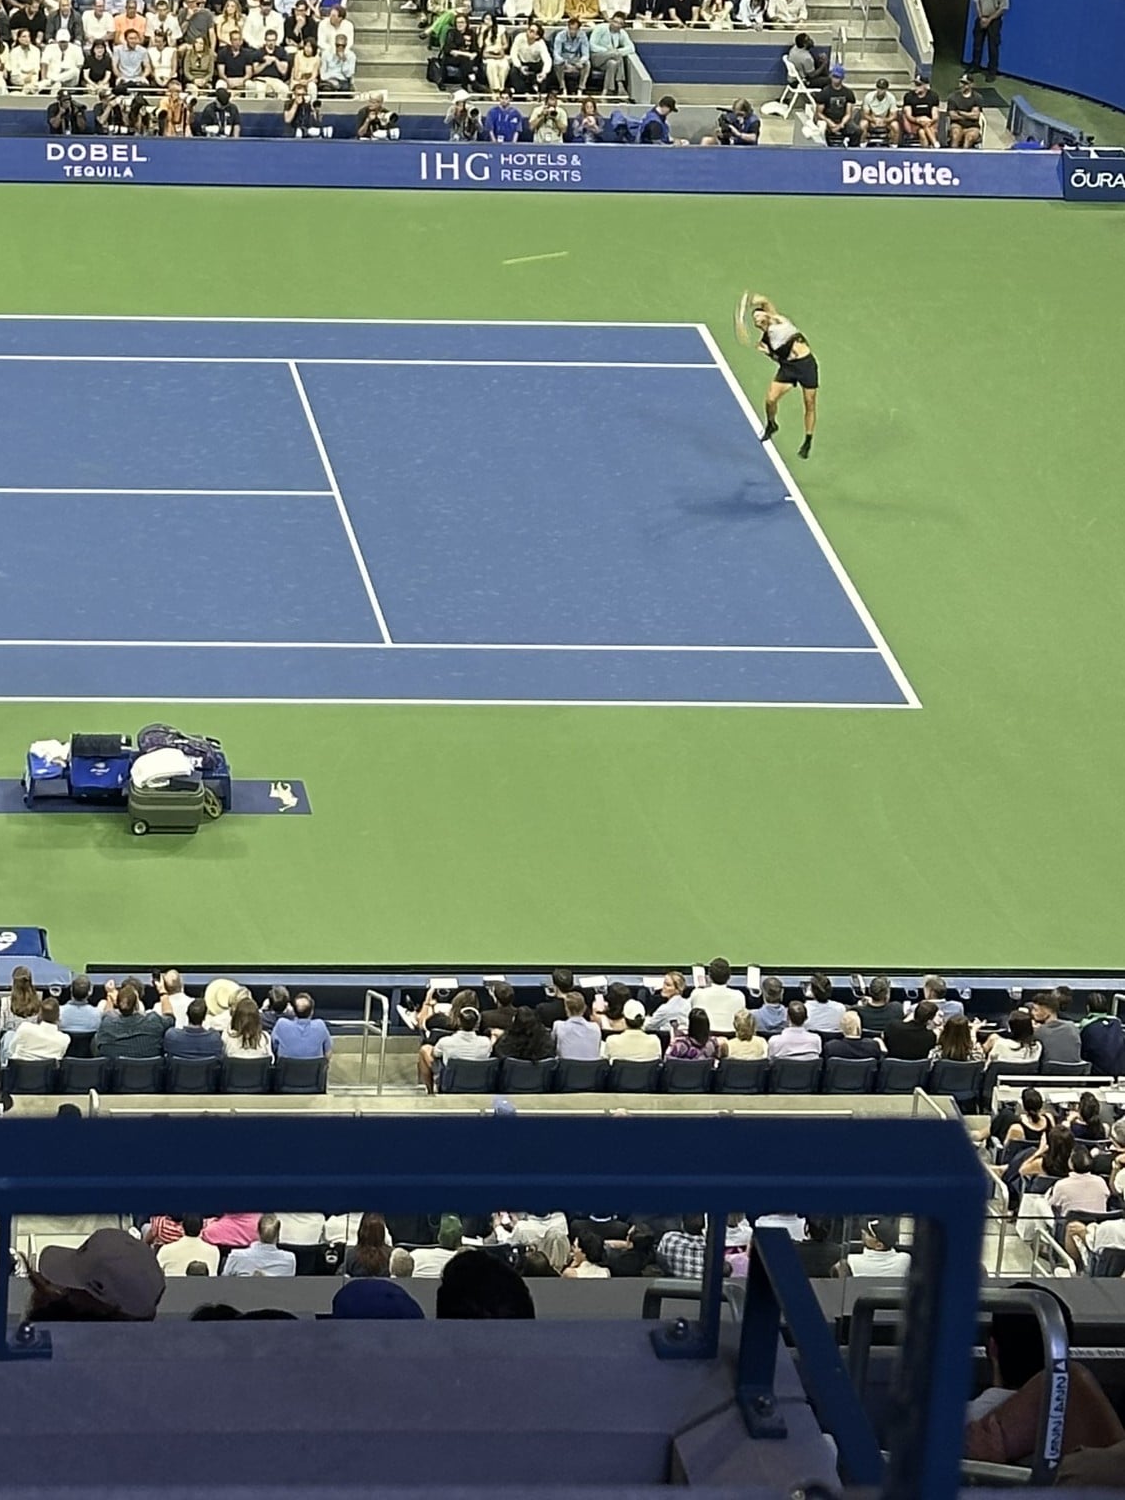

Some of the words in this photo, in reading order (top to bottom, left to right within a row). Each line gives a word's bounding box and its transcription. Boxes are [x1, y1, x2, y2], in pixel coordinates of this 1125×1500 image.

[46, 143, 148, 162] DOBEL
[63, 165, 134, 178] TEQUILA
[420, 152, 491, 181] IHG
[500, 153, 567, 166] HOTELS
[570, 154, 582, 166] &
[500, 169, 582, 183] RESORTS
[842, 160, 960, 186] Deloitte.
